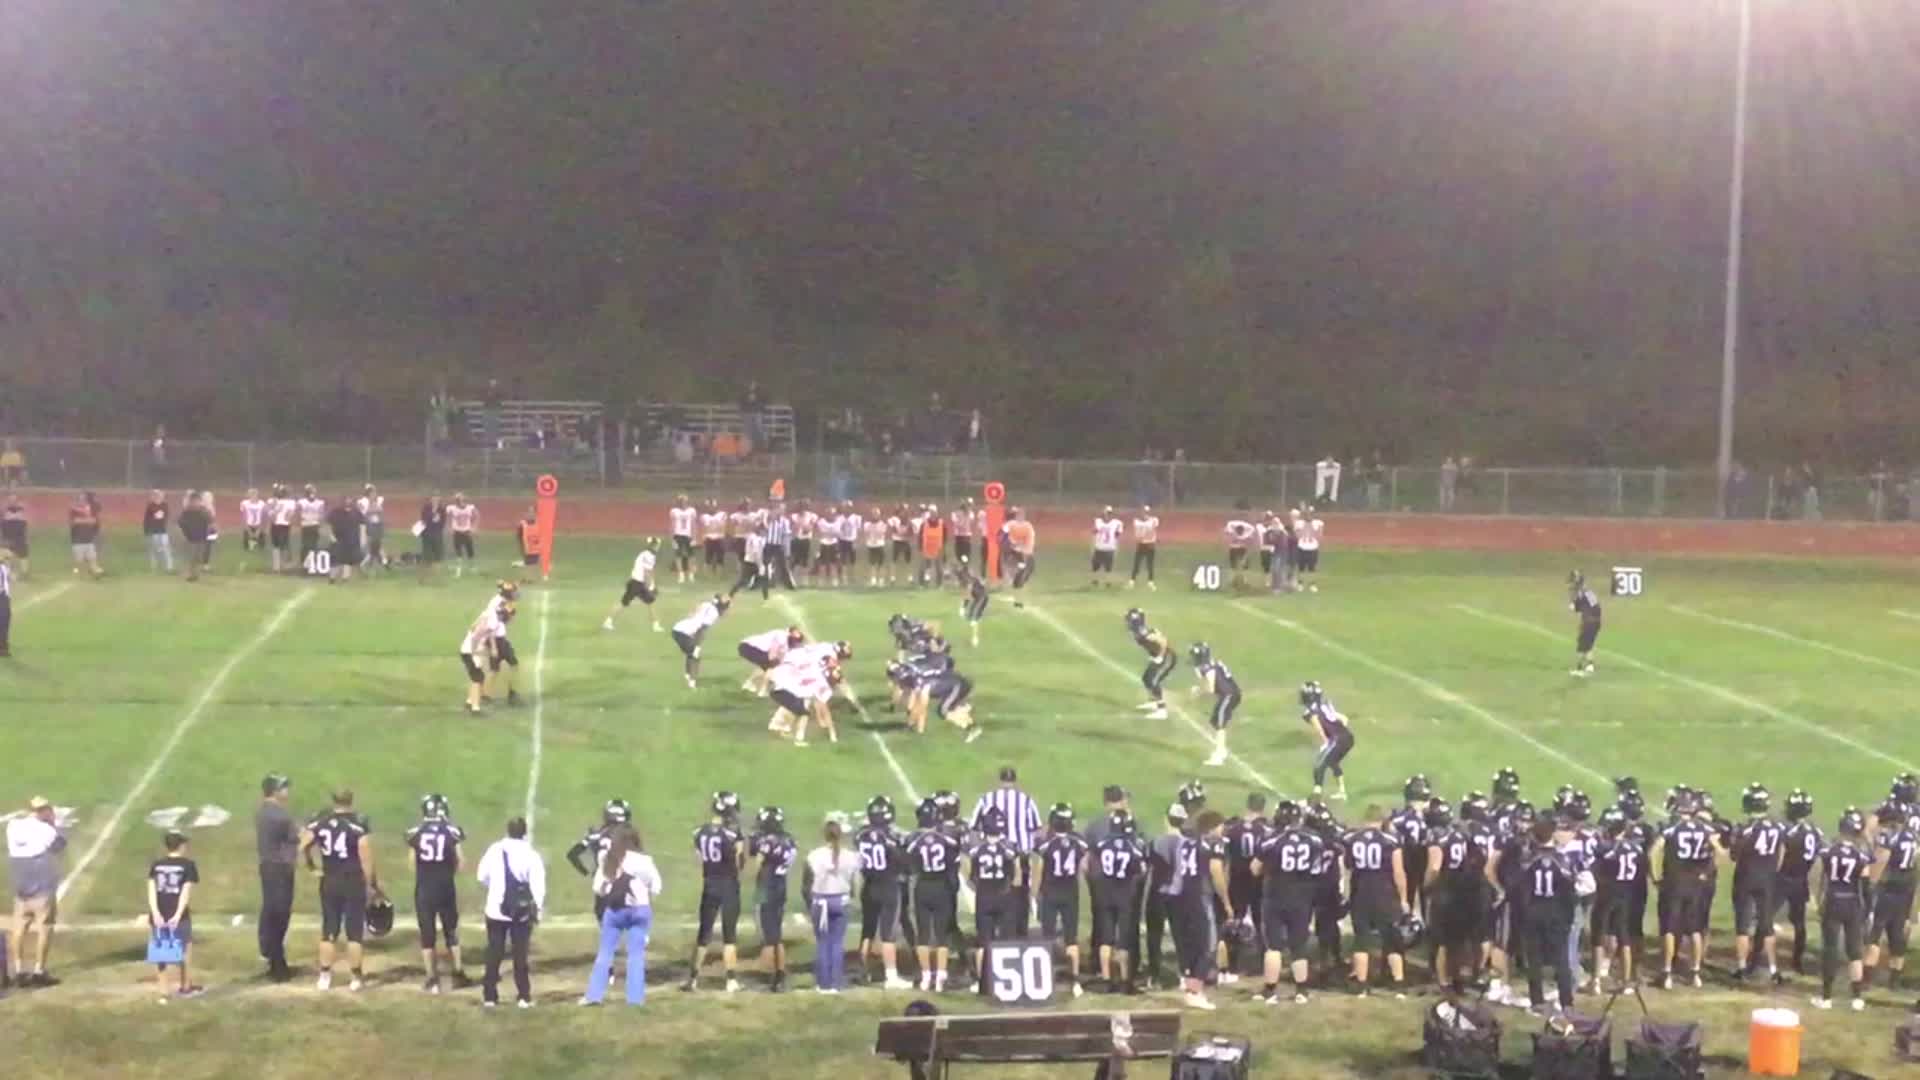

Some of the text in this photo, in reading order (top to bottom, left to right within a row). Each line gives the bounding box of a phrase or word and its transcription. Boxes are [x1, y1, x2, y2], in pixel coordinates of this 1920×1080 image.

[304, 550, 331, 574] 40
[1192, 565, 1220, 589] 40
[1615, 573, 1642, 595] 30
[318, 828, 349, 859] 34
[419, 832, 447, 862] 51
[700, 836, 722, 862] 16
[1351, 842, 1382, 870] 90
[1677, 832, 1705, 859] 57
[1754, 829, 1780, 856] 47
[1803, 835, 1816, 861] 9
[859, 843, 887, 871] 50
[920, 844, 946, 872] 12
[978, 853, 1005, 879] 21
[1052, 849, 1076, 877] 14
[1281, 843, 1310, 871] 62
[1616, 852, 1638, 881] 15
[1830, 856, 1856, 883] 17
[1534, 869, 1554, 897] 11
[991, 946, 1051, 1001] 50
